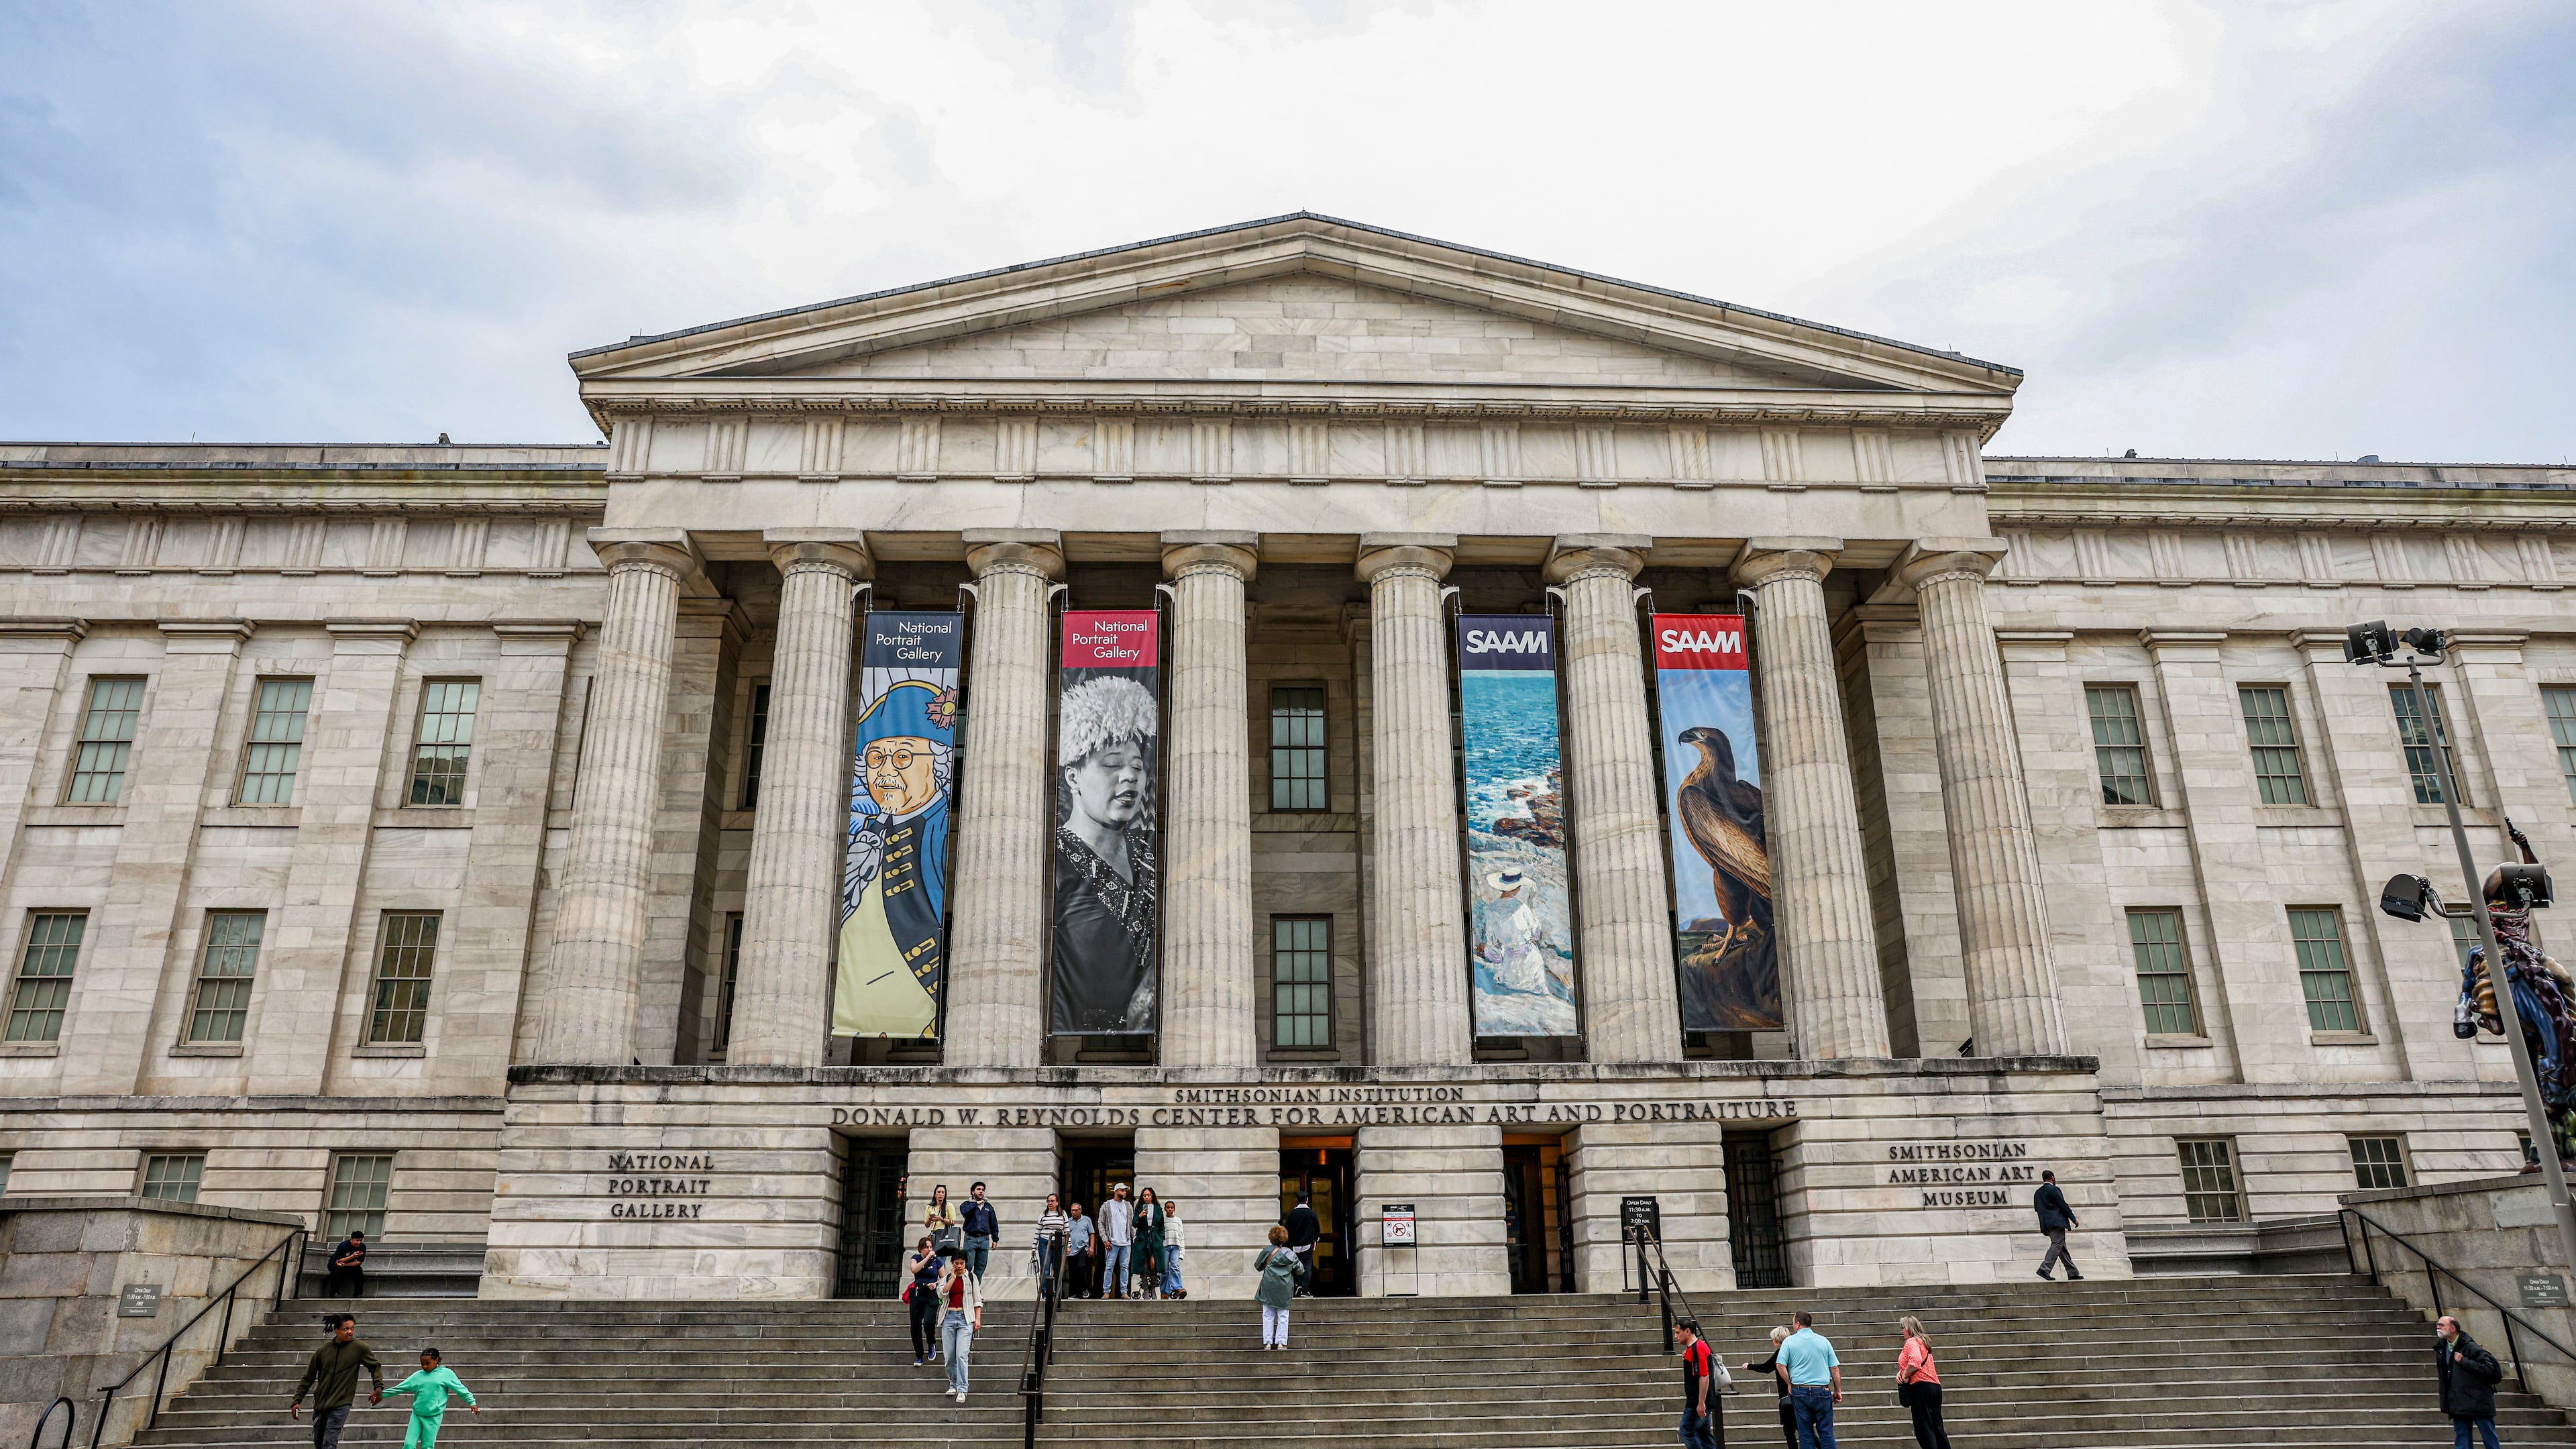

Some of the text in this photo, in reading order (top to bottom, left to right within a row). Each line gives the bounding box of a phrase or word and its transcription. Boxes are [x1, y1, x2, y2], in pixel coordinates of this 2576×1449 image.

[898, 621, 953, 634] National
[1094, 619, 1148, 633] National
[875, 634, 922, 646] Portrait
[1072, 633, 1118, 645] Portrait
[1465, 629, 1548, 654] SAAM
[1660, 629, 1741, 653] SAAM
[896, 647, 943, 661] Gallery
[1093, 646, 1140, 661] Gallery
[1175, 1087, 1463, 1102] SMITHSONIAN INSTITUTION
[832, 1101, 1797, 1125] DONALD W. REYNOLDS CENTER FOR AMERICAN ART AND PORTRAITURE
[1889, 1143, 2027, 1160] SMITHSONIAN
[608, 1155, 714, 1169] NATIONAL
[1889, 1166, 2034, 1183] AMERICAN ART
[608, 1179, 711, 1193] PORTRAIT
[1923, 1191, 2008, 1206] MUSEUM
[611, 1203, 702, 1218] GALLERY
